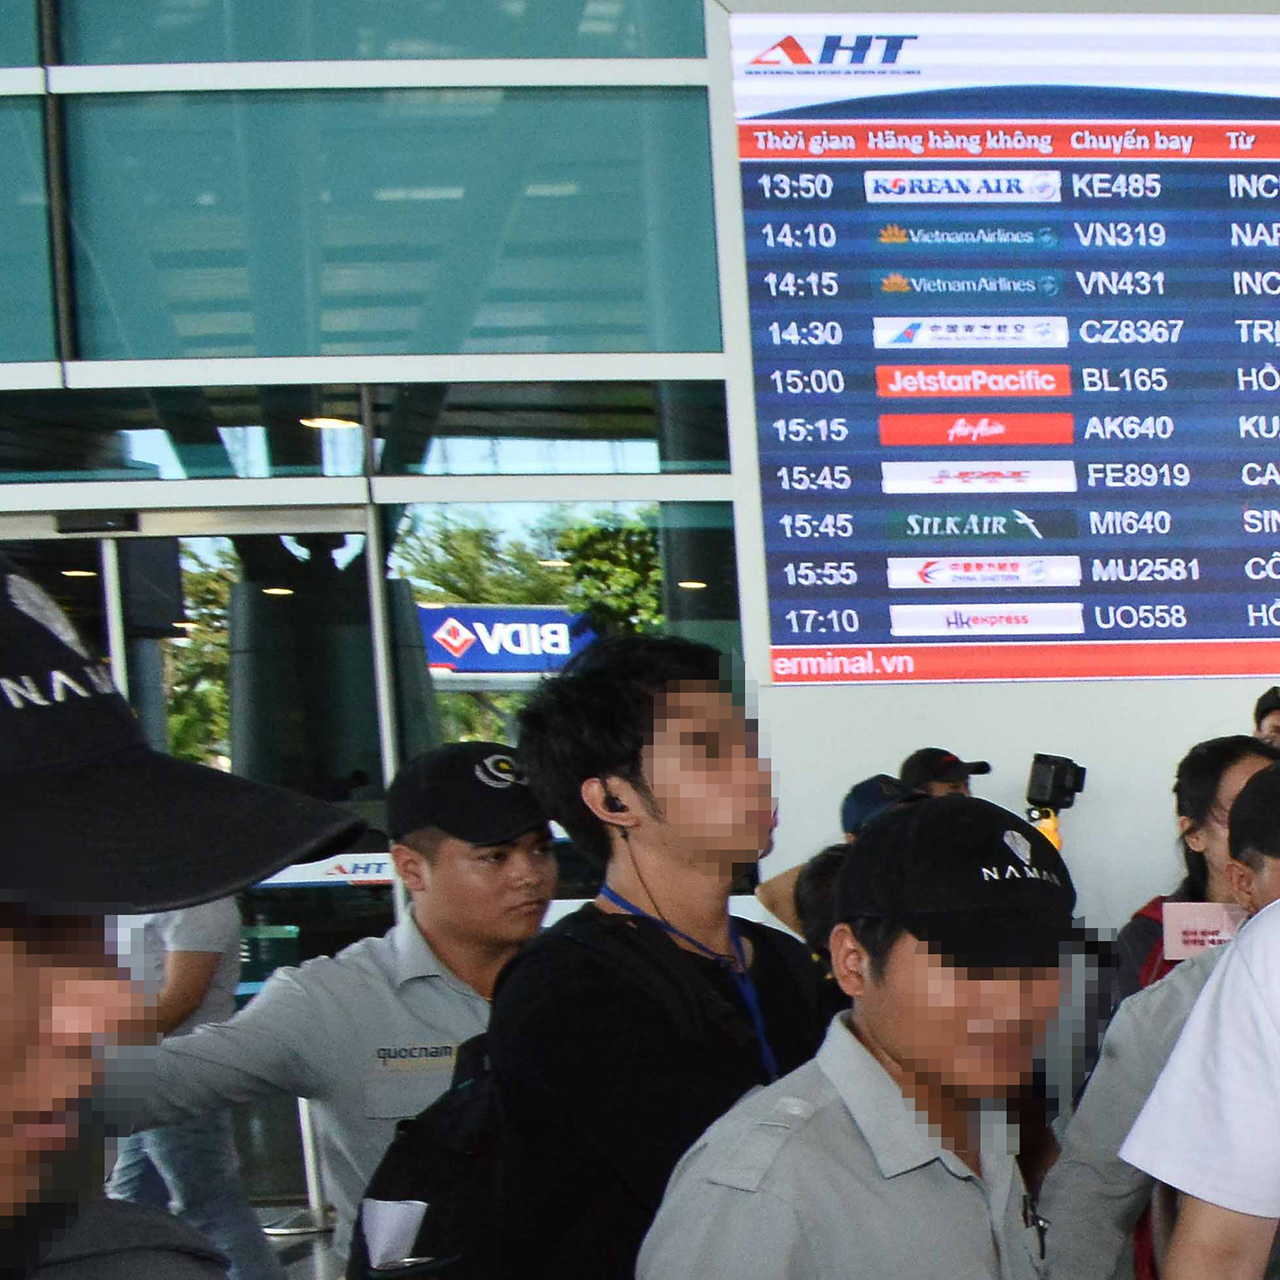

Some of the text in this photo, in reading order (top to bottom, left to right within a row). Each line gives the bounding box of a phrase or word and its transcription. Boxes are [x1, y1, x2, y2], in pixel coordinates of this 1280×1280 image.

[751, 35, 918, 64] AHT
[755, 130, 855, 154] Thời gian
[867, 129, 1052, 154] Hãng hàng không
[1070, 129, 1193, 154] Chuyến bay
[1227, 130, 1255, 150] Từ
[758, 174, 833, 198] 13:50
[873, 177, 1024, 195] KOREAN AIR
[1073, 174, 1161, 198] KE485
[762, 223, 836, 248] 14:10
[1075, 223, 1166, 247] VN319
[765, 272, 838, 296] 14:15
[1077, 272, 1164, 295] VN431
[768, 321, 842, 345] 14:30
[1080, 320, 1183, 344] CZ8367
[771, 370, 844, 394] 15:00
[888, 370, 1056, 393] JetstarPacific
[1083, 370, 1168, 392] BL165
[773, 418, 848, 442] 15:15
[1084, 417, 1174, 440] AK640
[777, 466, 851, 490] 15:45
[1088, 464, 1190, 487] FE8919
[780, 514, 853, 538] 15:45
[1090, 512, 1170, 535] MI640
[784, 563, 858, 586] 15:55
[1092, 558, 1200, 582] MU2581
[786, 610, 859, 634] 17:10
[1095, 606, 1186, 629] UO558
[774, 652, 914, 675] erminal.vn
[325, 862, 387, 876] AHT
